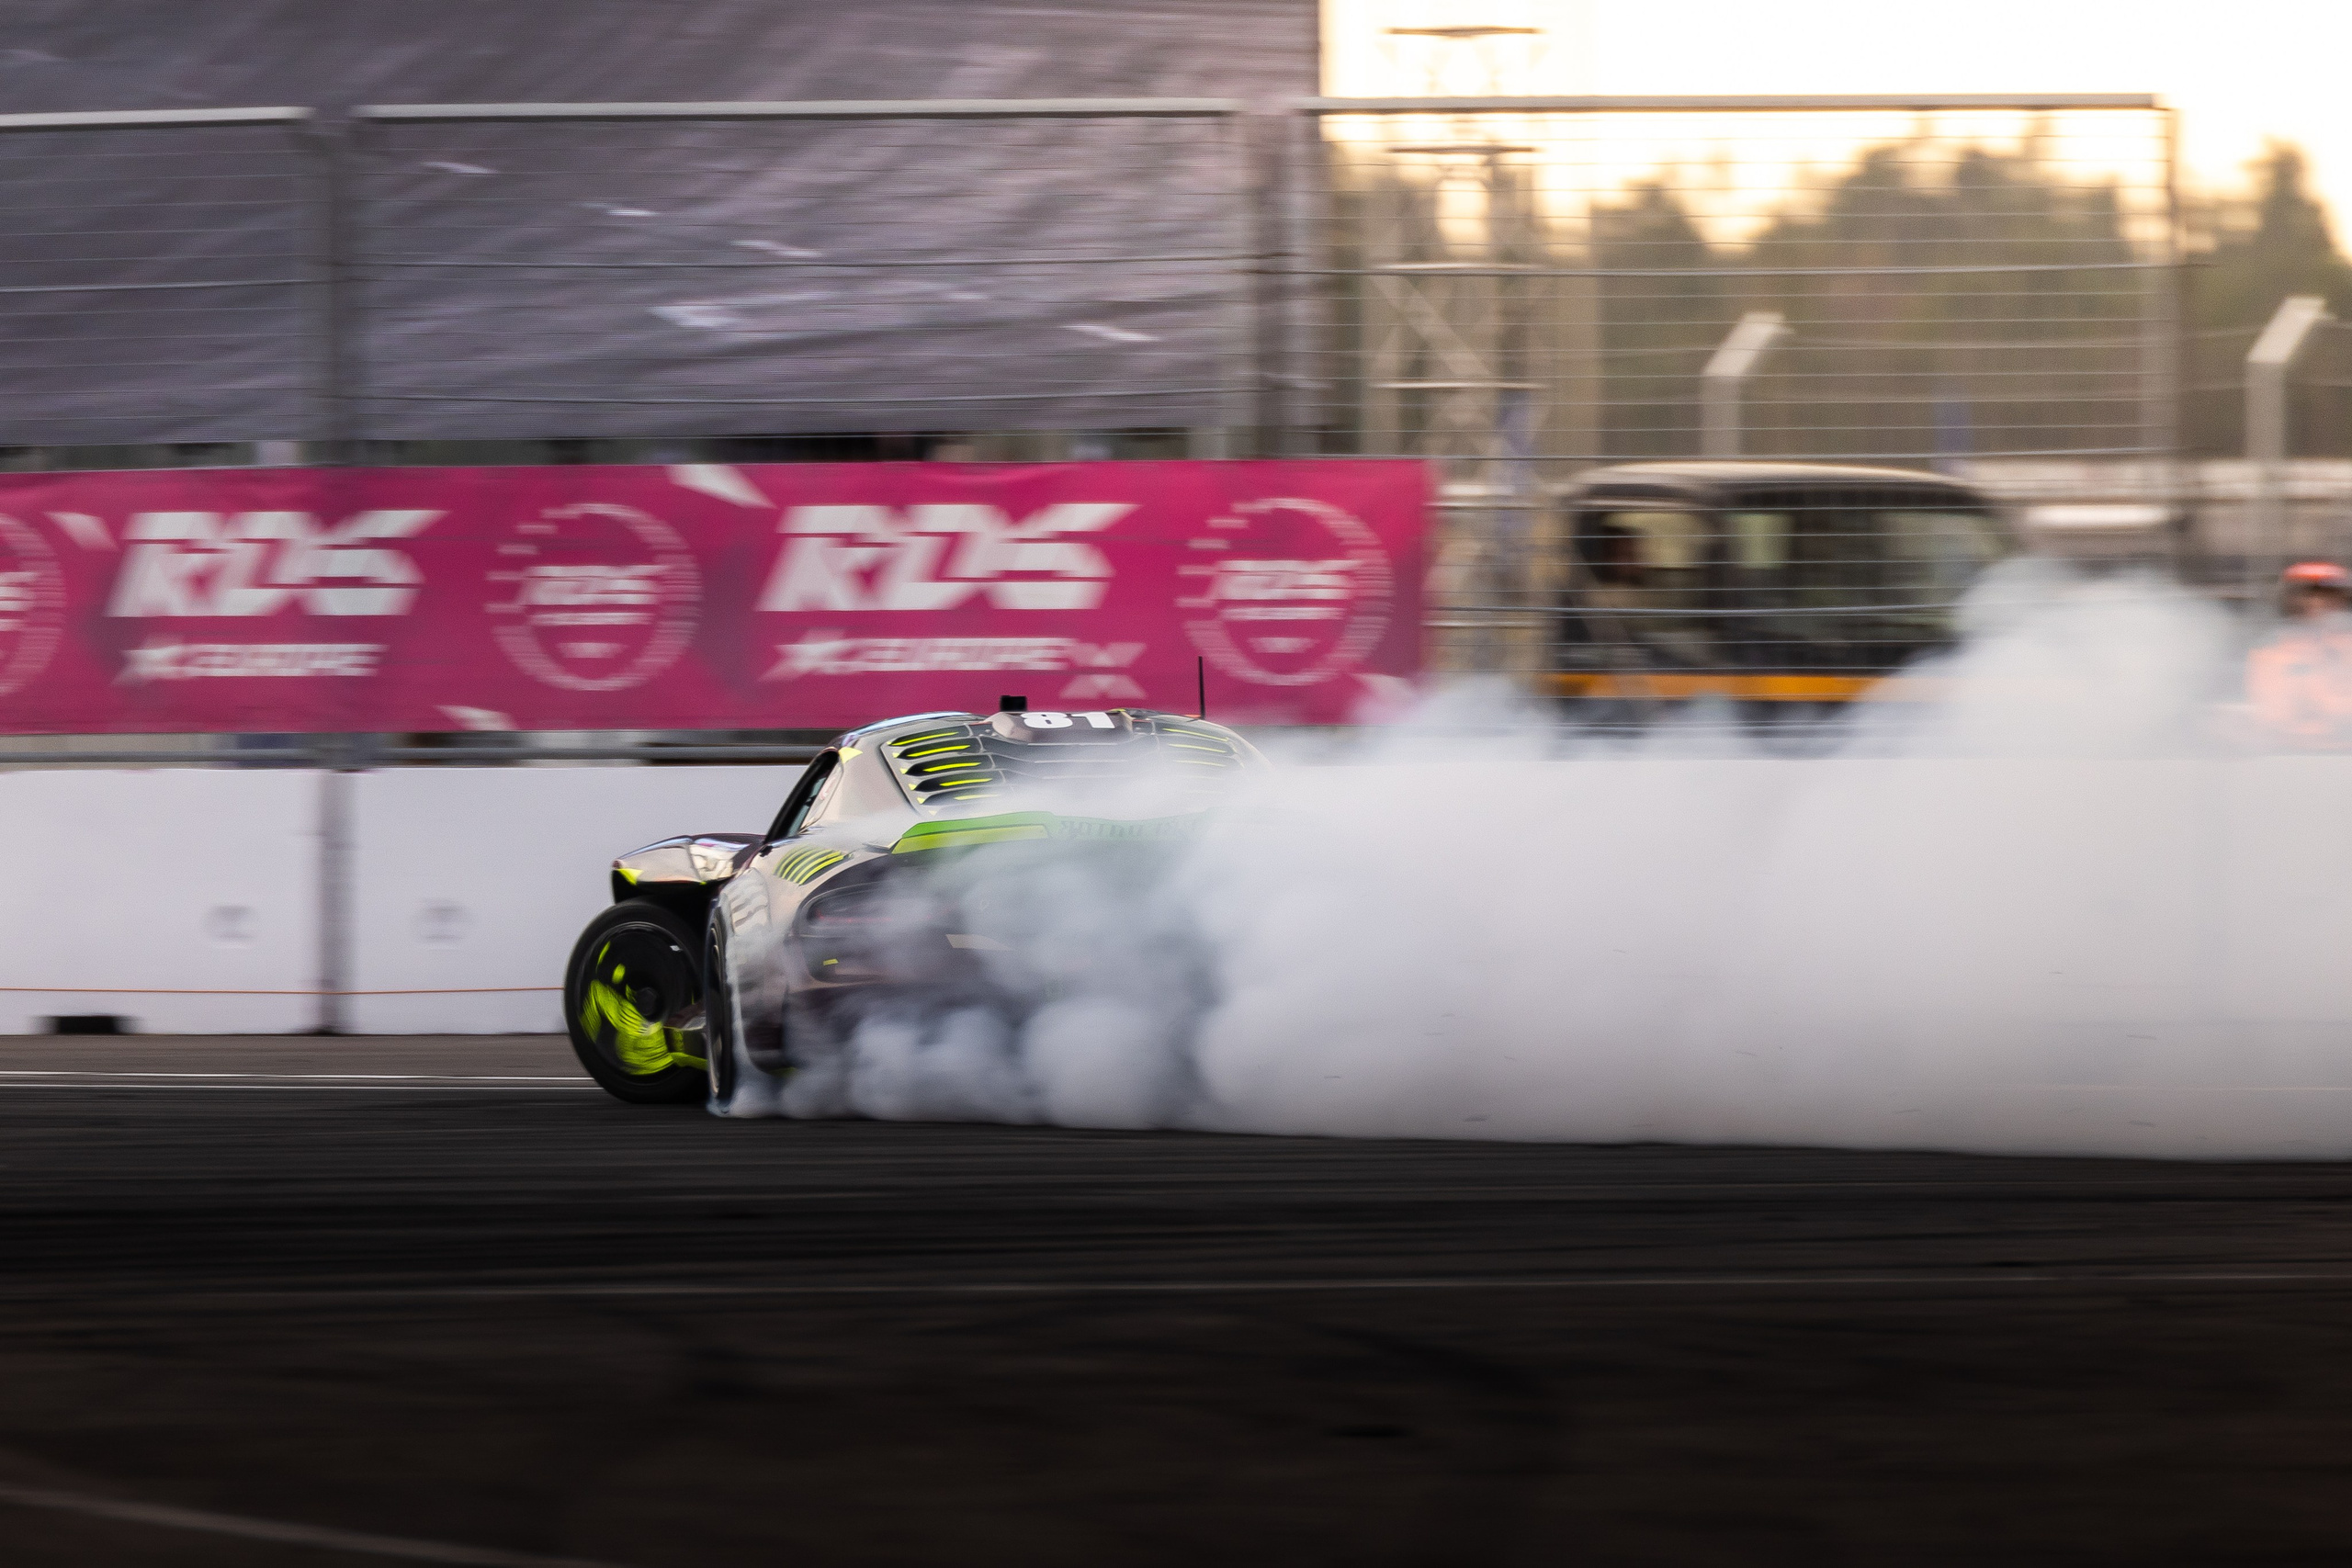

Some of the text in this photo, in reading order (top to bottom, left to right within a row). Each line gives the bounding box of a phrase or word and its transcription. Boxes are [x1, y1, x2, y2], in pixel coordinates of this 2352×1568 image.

[107, 510, 445, 616] RDS
[755, 503, 1136, 611] RDS
[1020, 712, 1115, 729] 81
